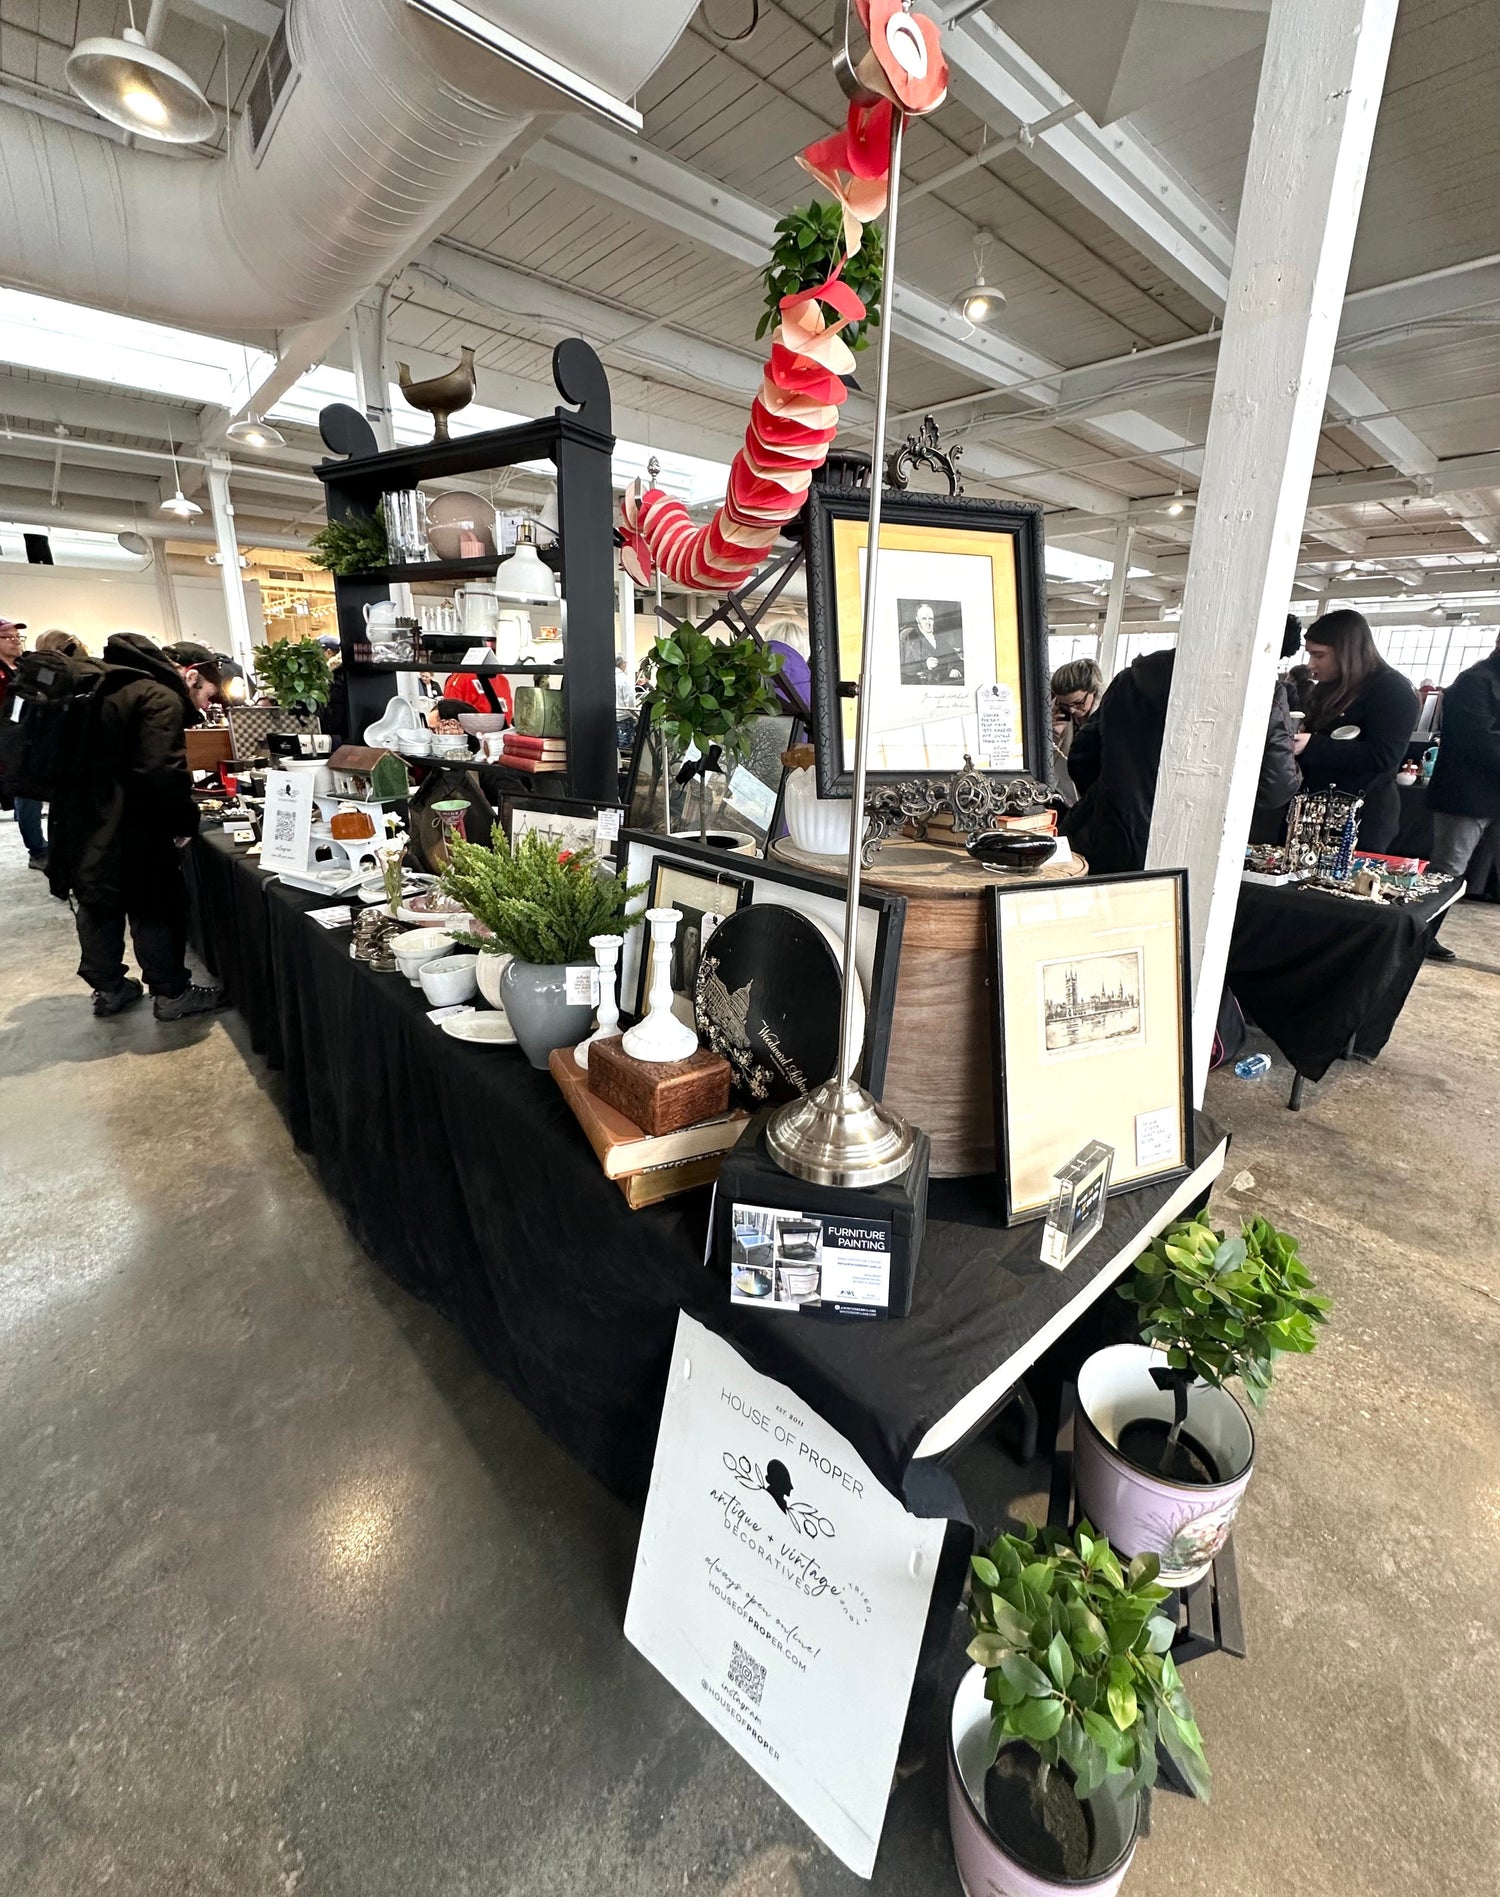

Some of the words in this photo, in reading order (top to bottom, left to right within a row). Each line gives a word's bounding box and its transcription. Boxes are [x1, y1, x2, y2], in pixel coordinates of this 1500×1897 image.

[758, 1019, 794, 1067] Woodward
[828, 1226, 886, 1241] FURNITURE
[838, 1237, 885, 1250] PAINTING
[720, 1387, 770, 1432] HOUSE
[774, 1425, 797, 1446] OF
[799, 1441, 864, 1499] PROPER
[789, 1413, 805, 1427] 2011
[710, 1489, 762, 1532] antique
[780, 1543, 842, 1597] vintage
[724, 1518, 810, 1596] DECORATIVES
[705, 1556, 741, 1590] always
[743, 1592, 771, 1618] open
[776, 1618, 821, 1659] online!
[708, 1580, 807, 1673] HOUSEOFPROPER.COM
[701, 1678, 780, 1762] @HOUSEOFPROPER
[721, 1682, 762, 1725] instagram
